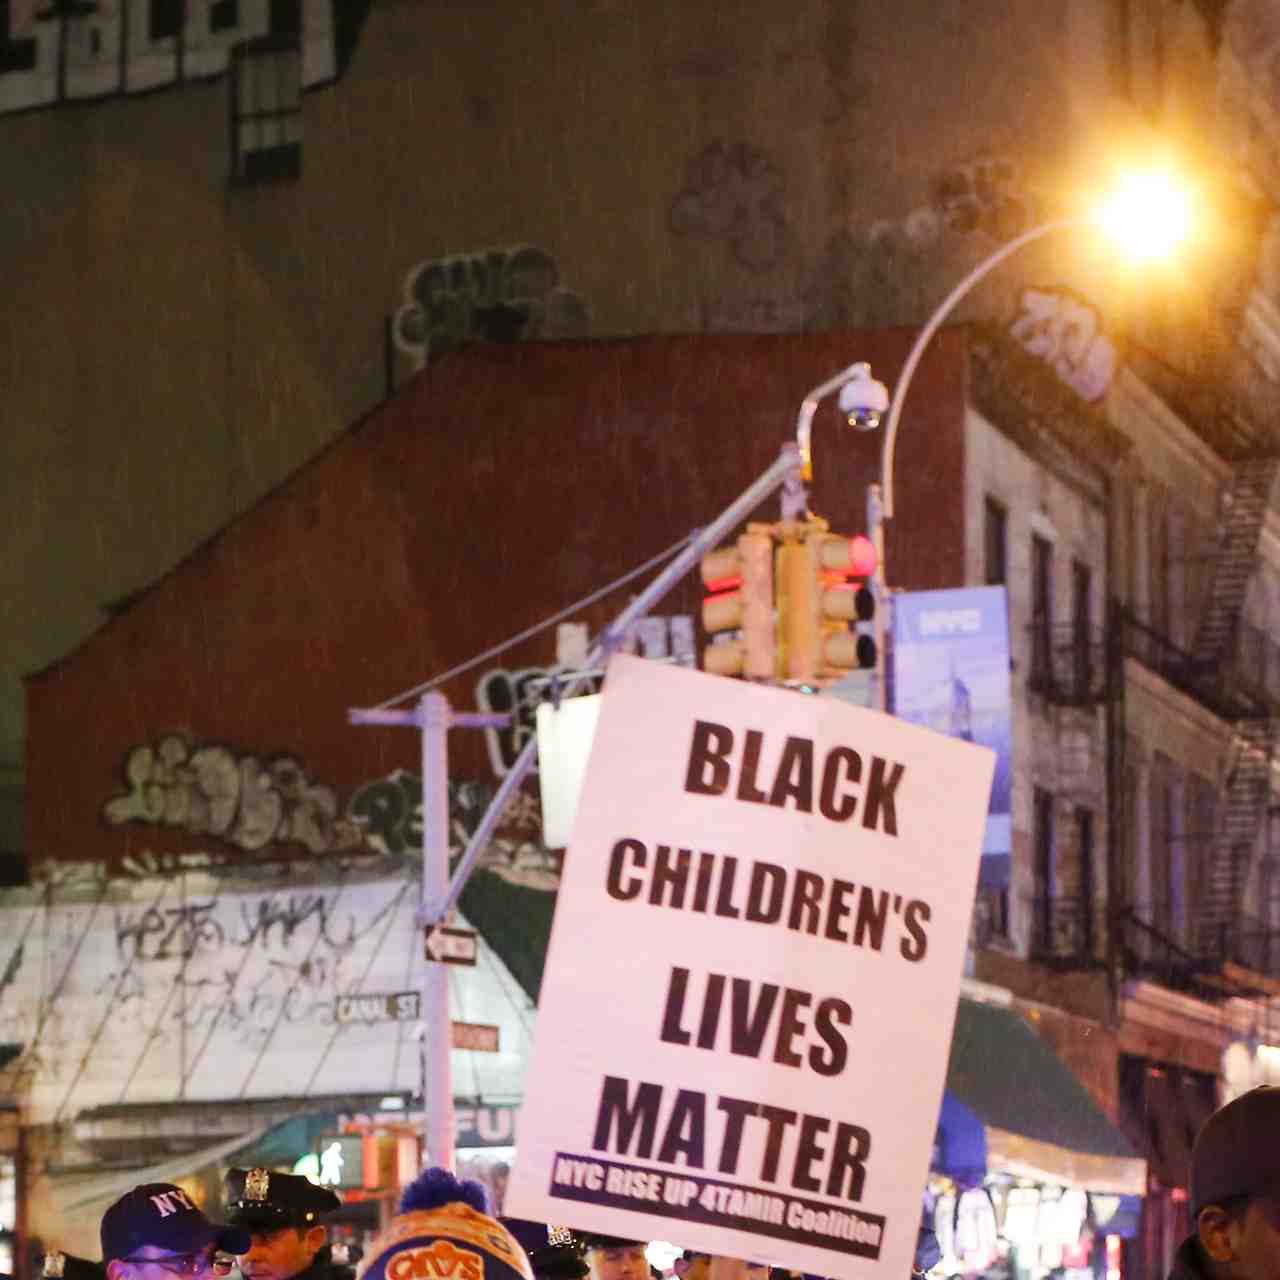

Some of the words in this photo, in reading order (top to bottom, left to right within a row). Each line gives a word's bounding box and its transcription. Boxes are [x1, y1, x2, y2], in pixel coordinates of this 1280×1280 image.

[684, 719, 906, 837] BLACK
[606, 838, 931, 963] CHILDREN'S
[336, 996, 388, 1021] CANAL
[397, 994, 419, 1019] ST
[659, 966, 853, 1077] LIVES
[592, 1075, 871, 1202] MATTER
[554, 1157, 603, 1191] NYC
[605, 1167, 662, 1203] RISE
[663, 1174, 697, 1207] UP
[786, 1201, 883, 1247] Coalition
